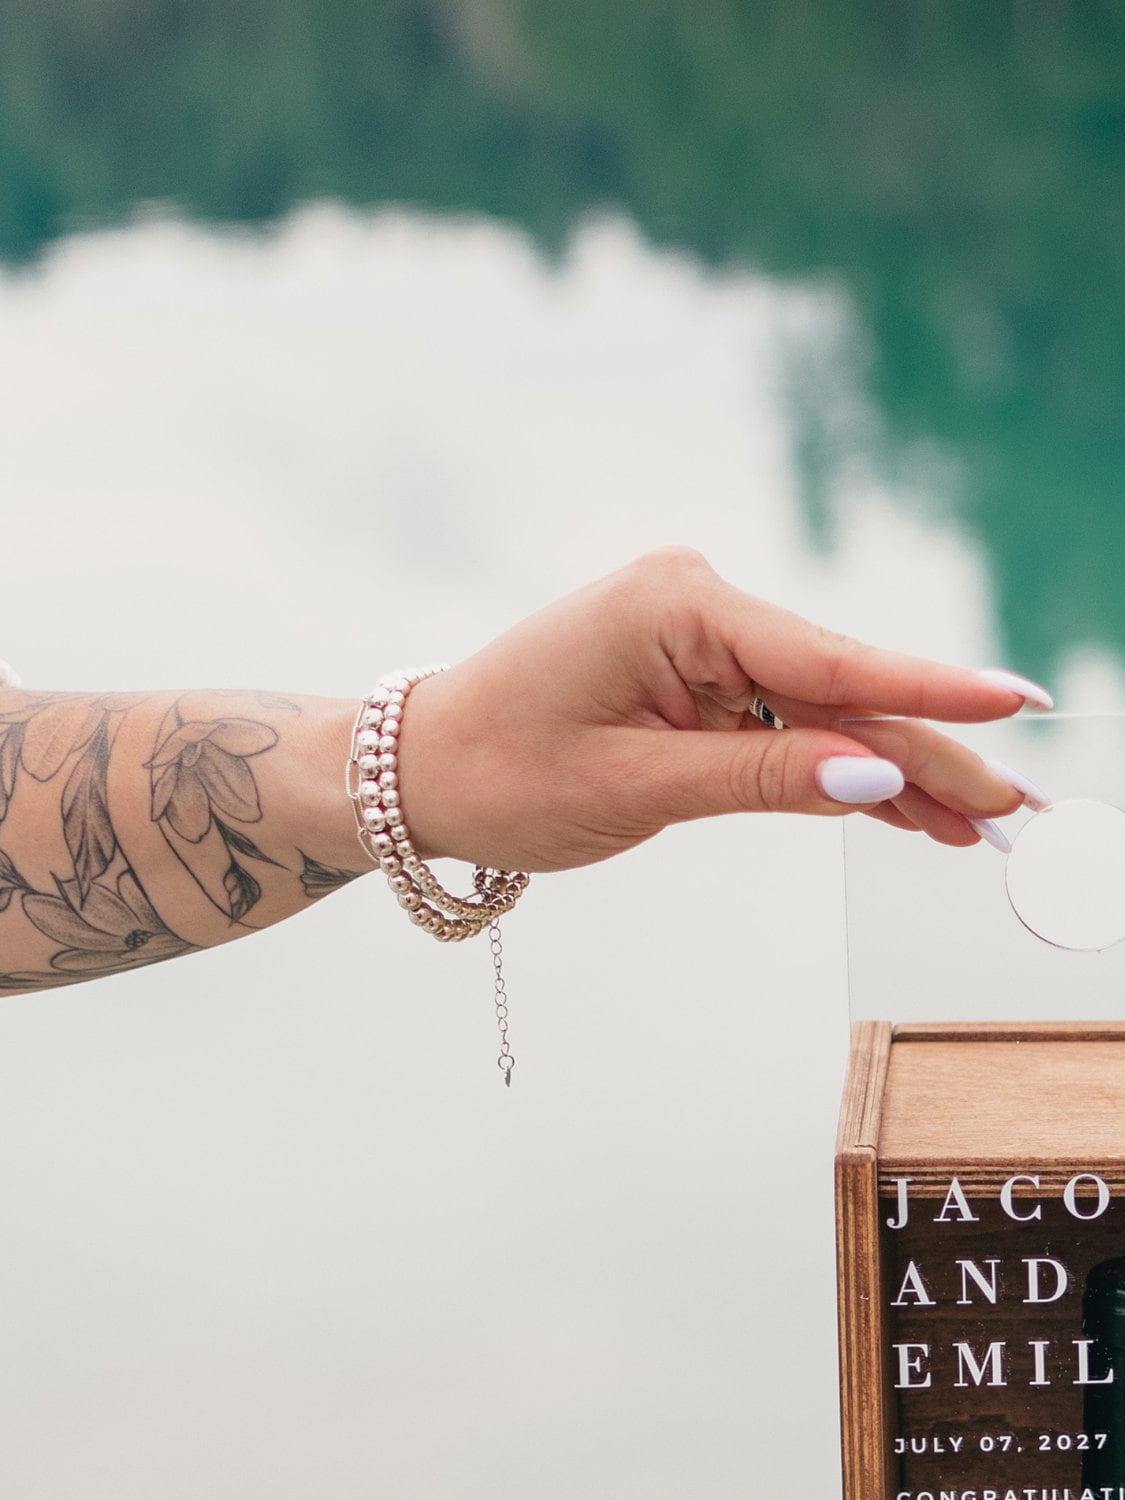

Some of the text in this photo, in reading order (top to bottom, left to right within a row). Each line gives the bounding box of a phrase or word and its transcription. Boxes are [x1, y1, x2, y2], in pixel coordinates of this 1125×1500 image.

[890, 1258, 1069, 1306] AND
[894, 1433, 1109, 1454] JULY 07, 2027
